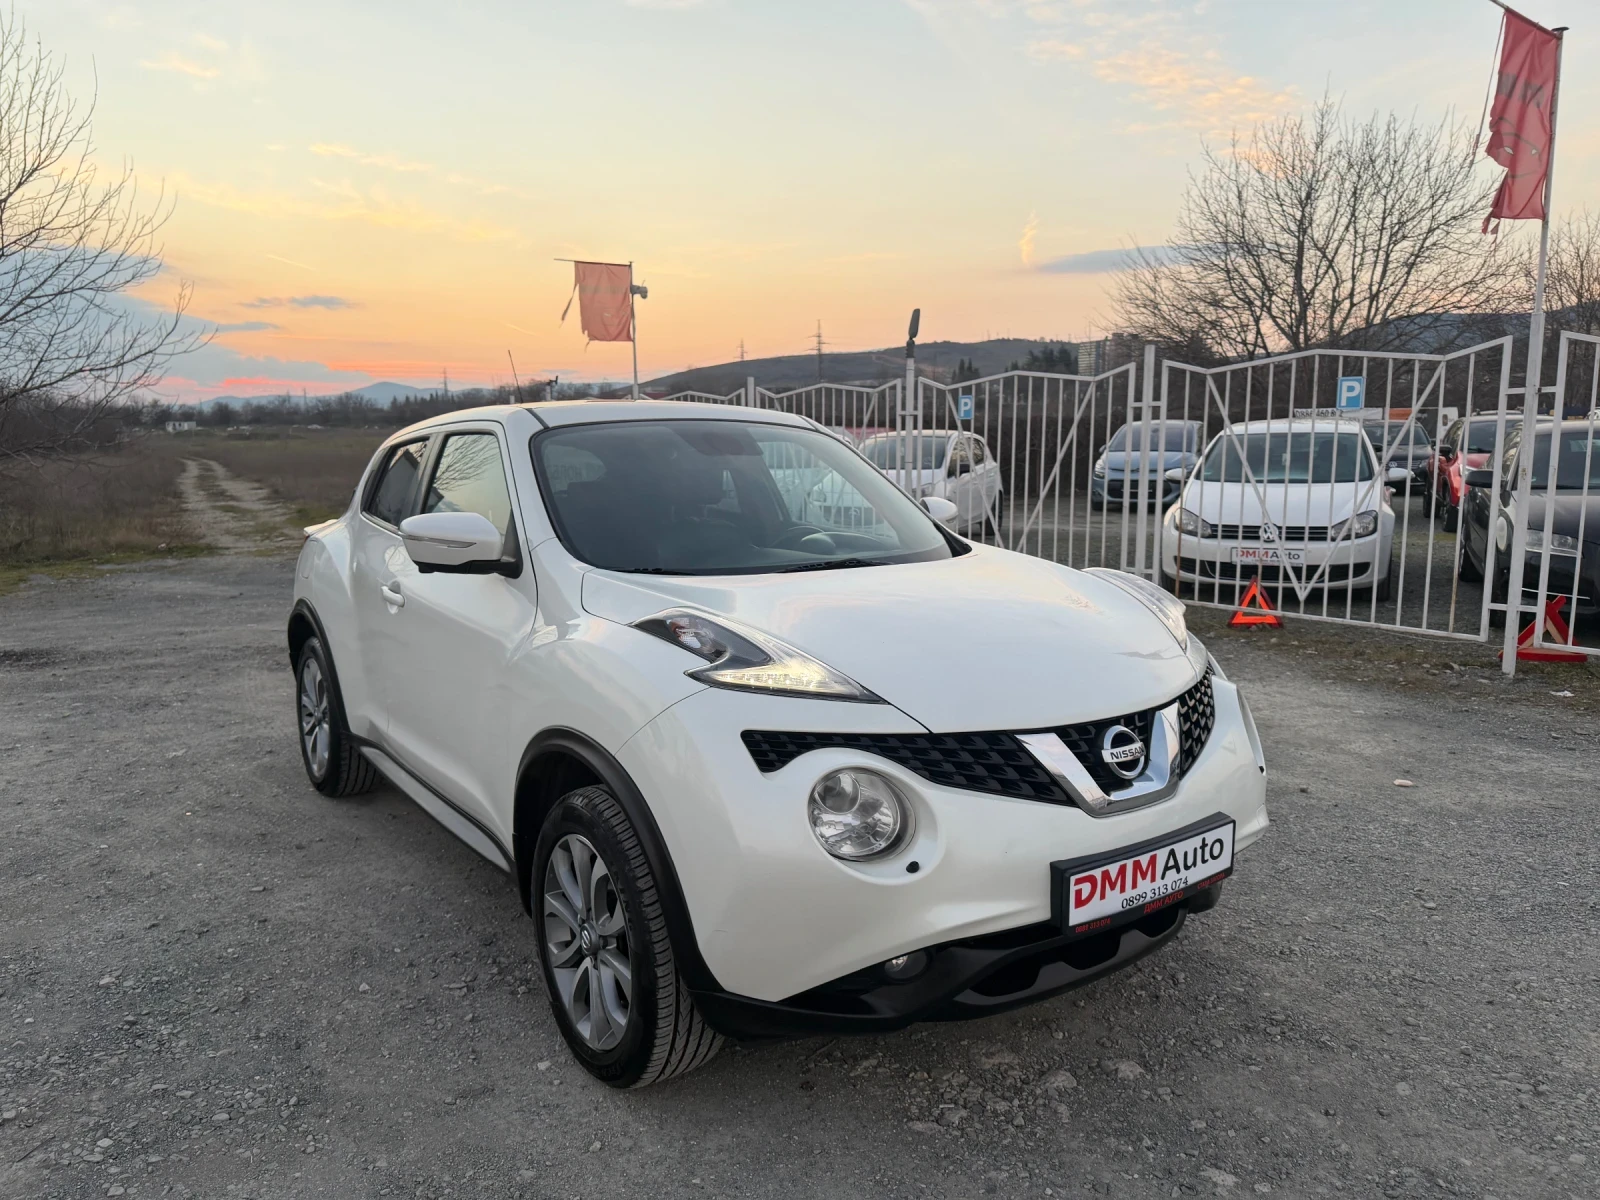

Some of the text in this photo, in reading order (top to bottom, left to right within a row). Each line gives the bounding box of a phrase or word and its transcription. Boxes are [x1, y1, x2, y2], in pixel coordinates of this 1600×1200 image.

[1340, 381, 1360, 406] P
[960, 398, 971, 417] P
[1270, 551, 1300, 560] Ato
[1110, 745, 1145, 760] NISSAN
[1121, 876, 1188, 909] 0899 313 074
[1144, 890, 1184, 914] ДММ АУТО
